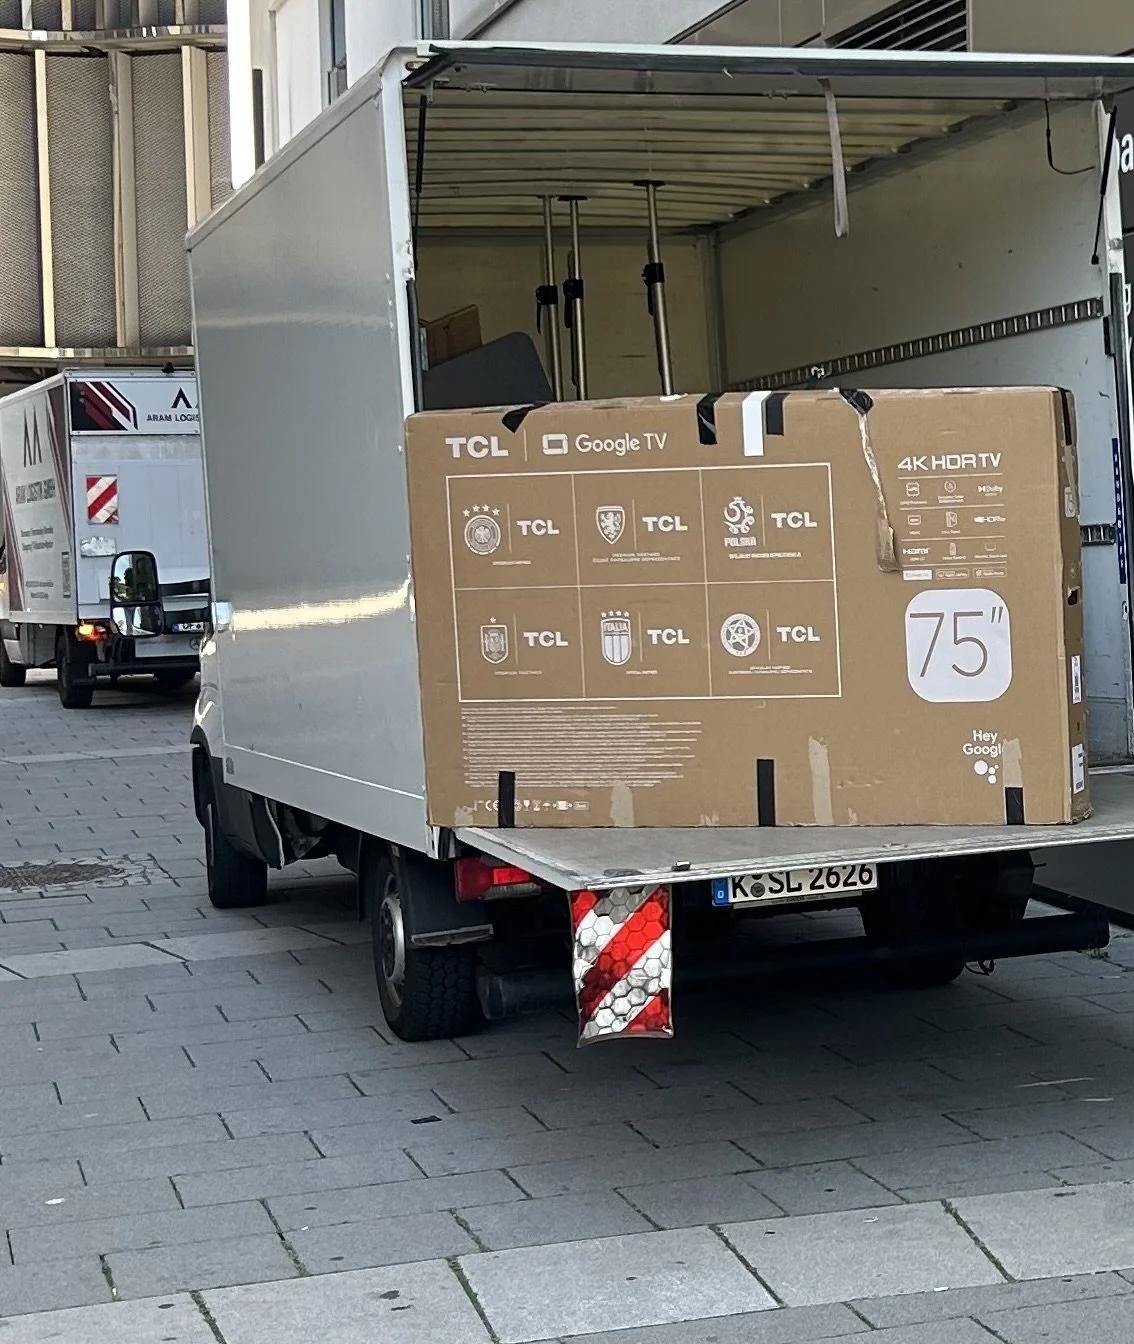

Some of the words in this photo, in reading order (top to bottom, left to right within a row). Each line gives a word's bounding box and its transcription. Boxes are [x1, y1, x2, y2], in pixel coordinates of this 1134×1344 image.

[445, 435, 509, 459] TCL
[574, 433, 641, 457] Google
[643, 432, 668, 450] TV
[897, 455, 929, 472] 4K
[516, 518, 560, 536] TCL
[642, 515, 689, 533] TCL
[771, 511, 818, 529] TCL
[603, 621, 629, 632] ITALIA
[776, 625, 821, 643] TCL
[523, 630, 569, 647] TCL
[647, 628, 690, 645] TCL
[909, 606, 1004, 678] 75"
[972, 729, 998, 745] Hey
[962, 743, 1004, 758] Googl
[809, 863, 874, 891] 2626
